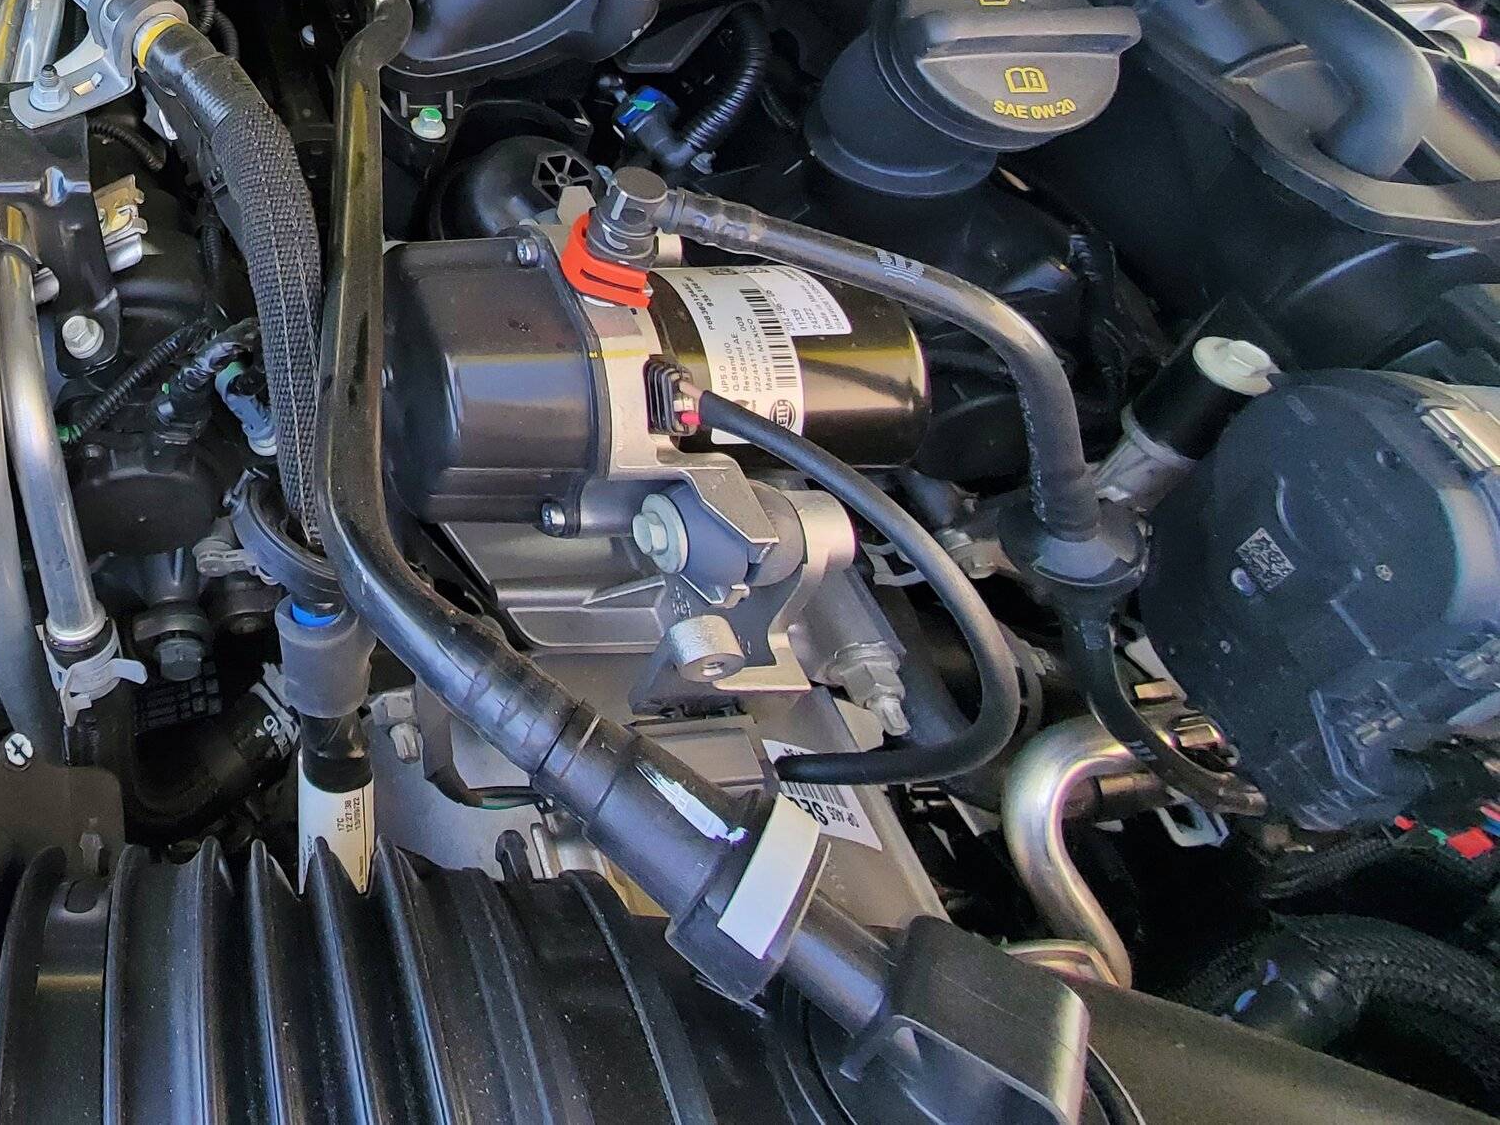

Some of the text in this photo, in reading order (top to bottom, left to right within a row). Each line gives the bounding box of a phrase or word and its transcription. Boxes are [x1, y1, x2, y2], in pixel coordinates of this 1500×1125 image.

[993, 98, 1077, 120] SAE 0W-20
[764, 370, 773, 391] Made
[777, 399, 789, 428] ELLA
